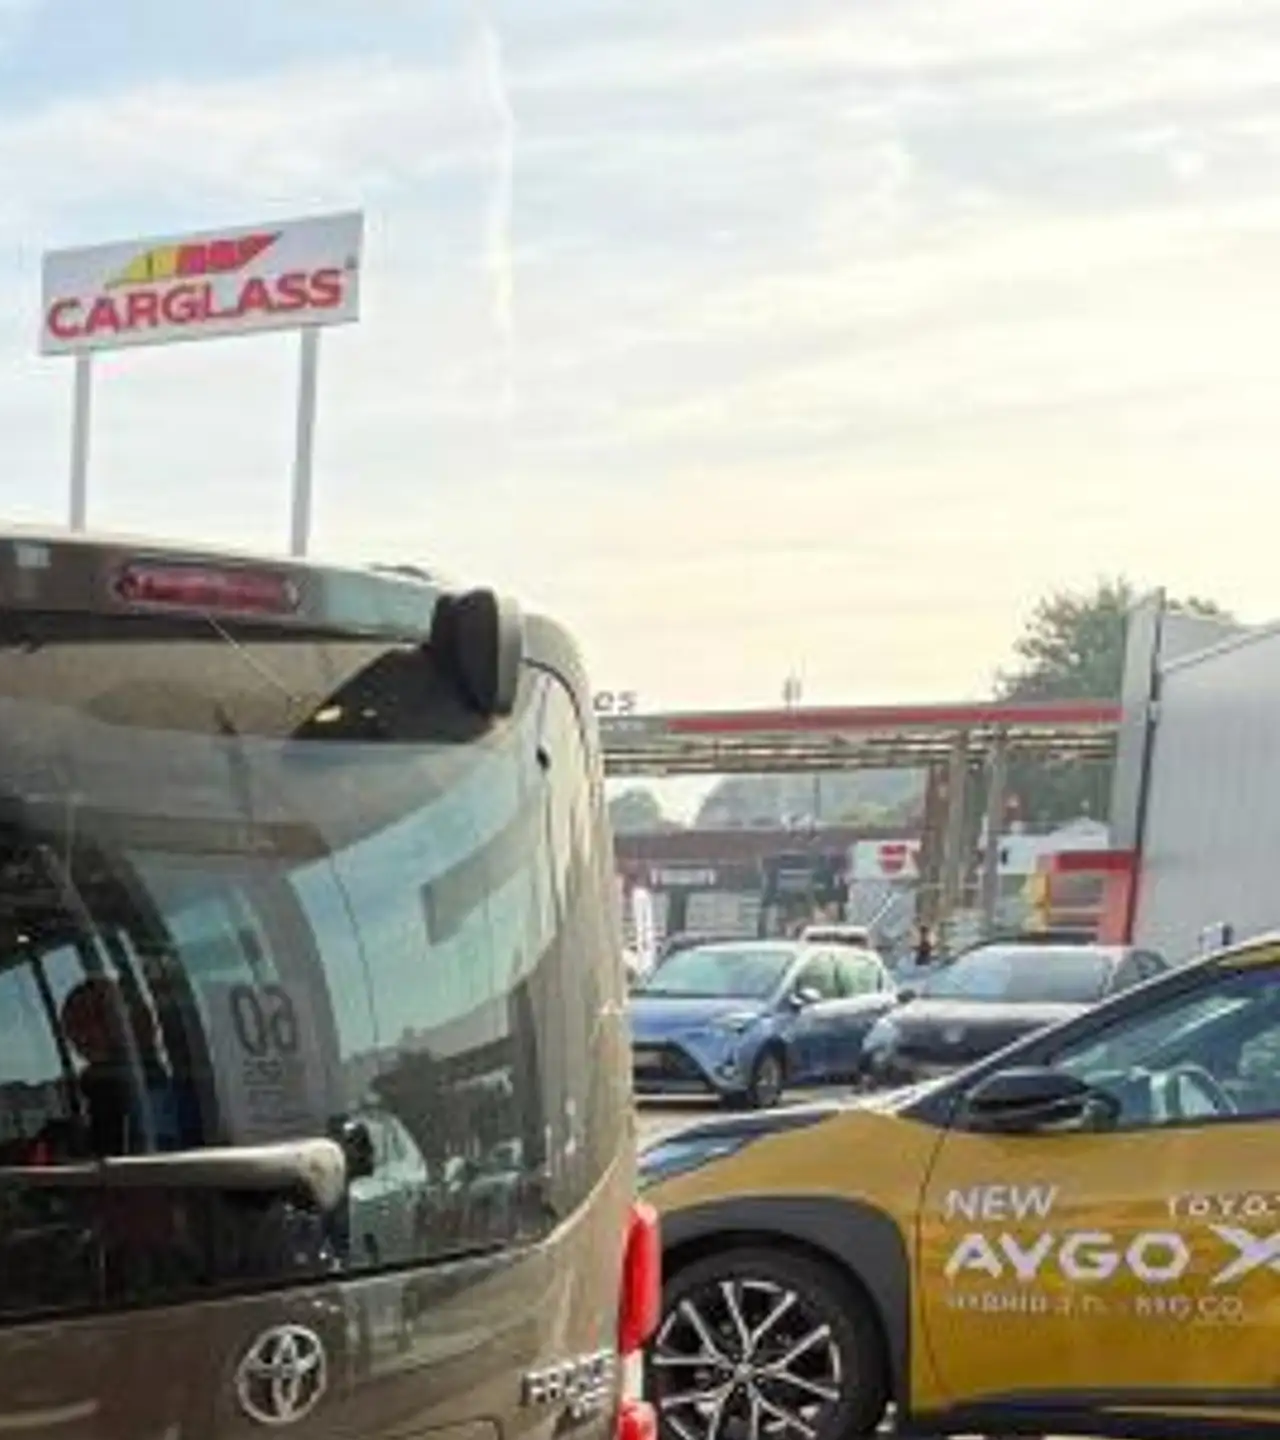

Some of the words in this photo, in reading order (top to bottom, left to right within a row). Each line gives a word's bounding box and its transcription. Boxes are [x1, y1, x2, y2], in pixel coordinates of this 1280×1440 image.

[46, 268, 343, 339] CARGLASS
[945, 1184, 1059, 1221] NEW
[944, 1232, 1190, 1281] AYGO
